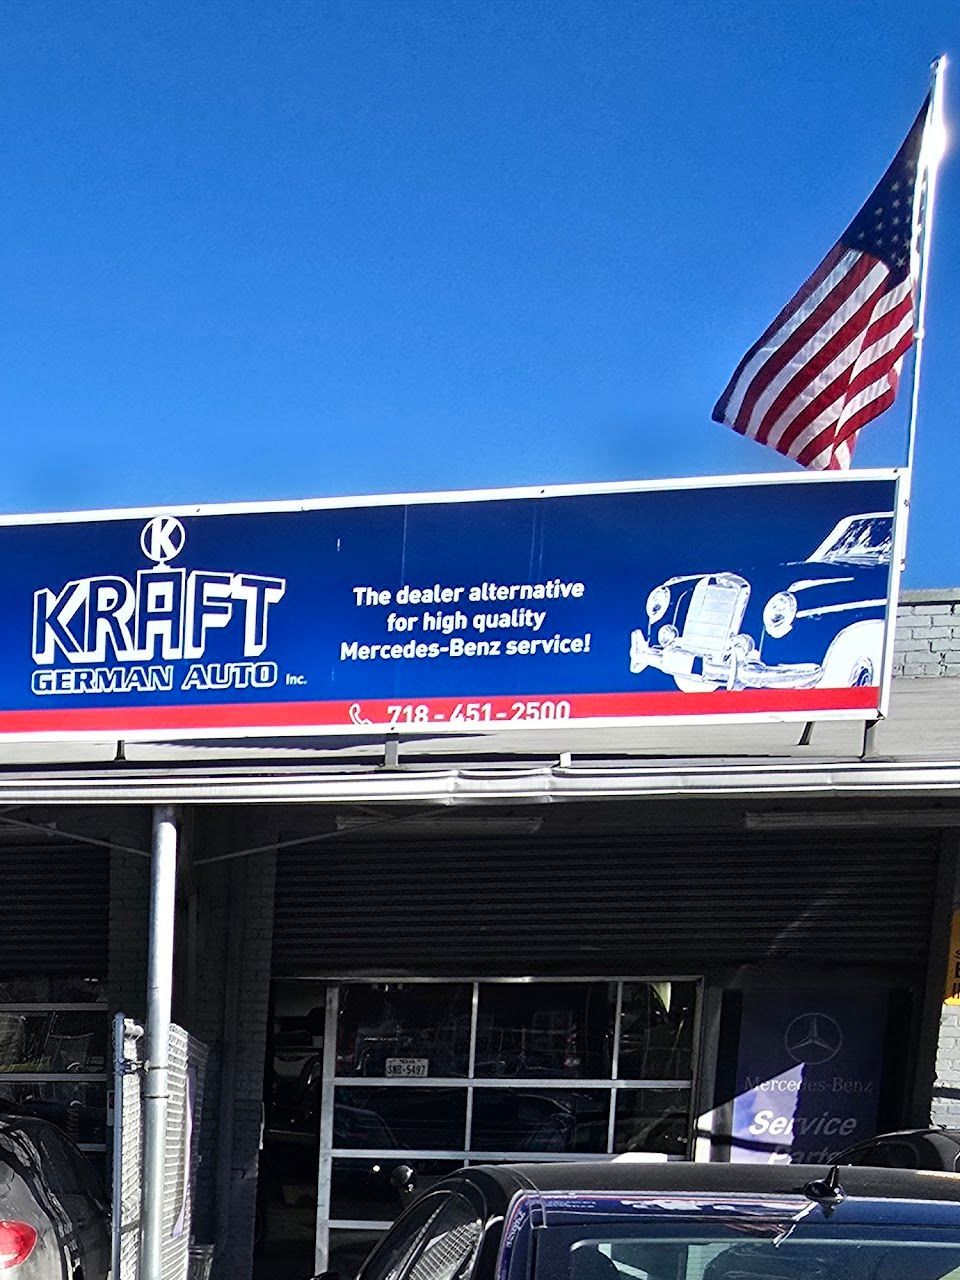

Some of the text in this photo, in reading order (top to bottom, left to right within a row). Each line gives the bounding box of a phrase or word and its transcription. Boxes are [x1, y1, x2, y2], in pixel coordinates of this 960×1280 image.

[352, 578, 586, 607] The dealer alternative
[31, 567, 287, 665] KRAFT
[386, 607, 547, 634] for high quality
[339, 633, 592, 661] Mercedes-Benz service!
[30, 660, 309, 696] GERMAN AUTO Inc.
[748, 1110, 859, 1137] Service
